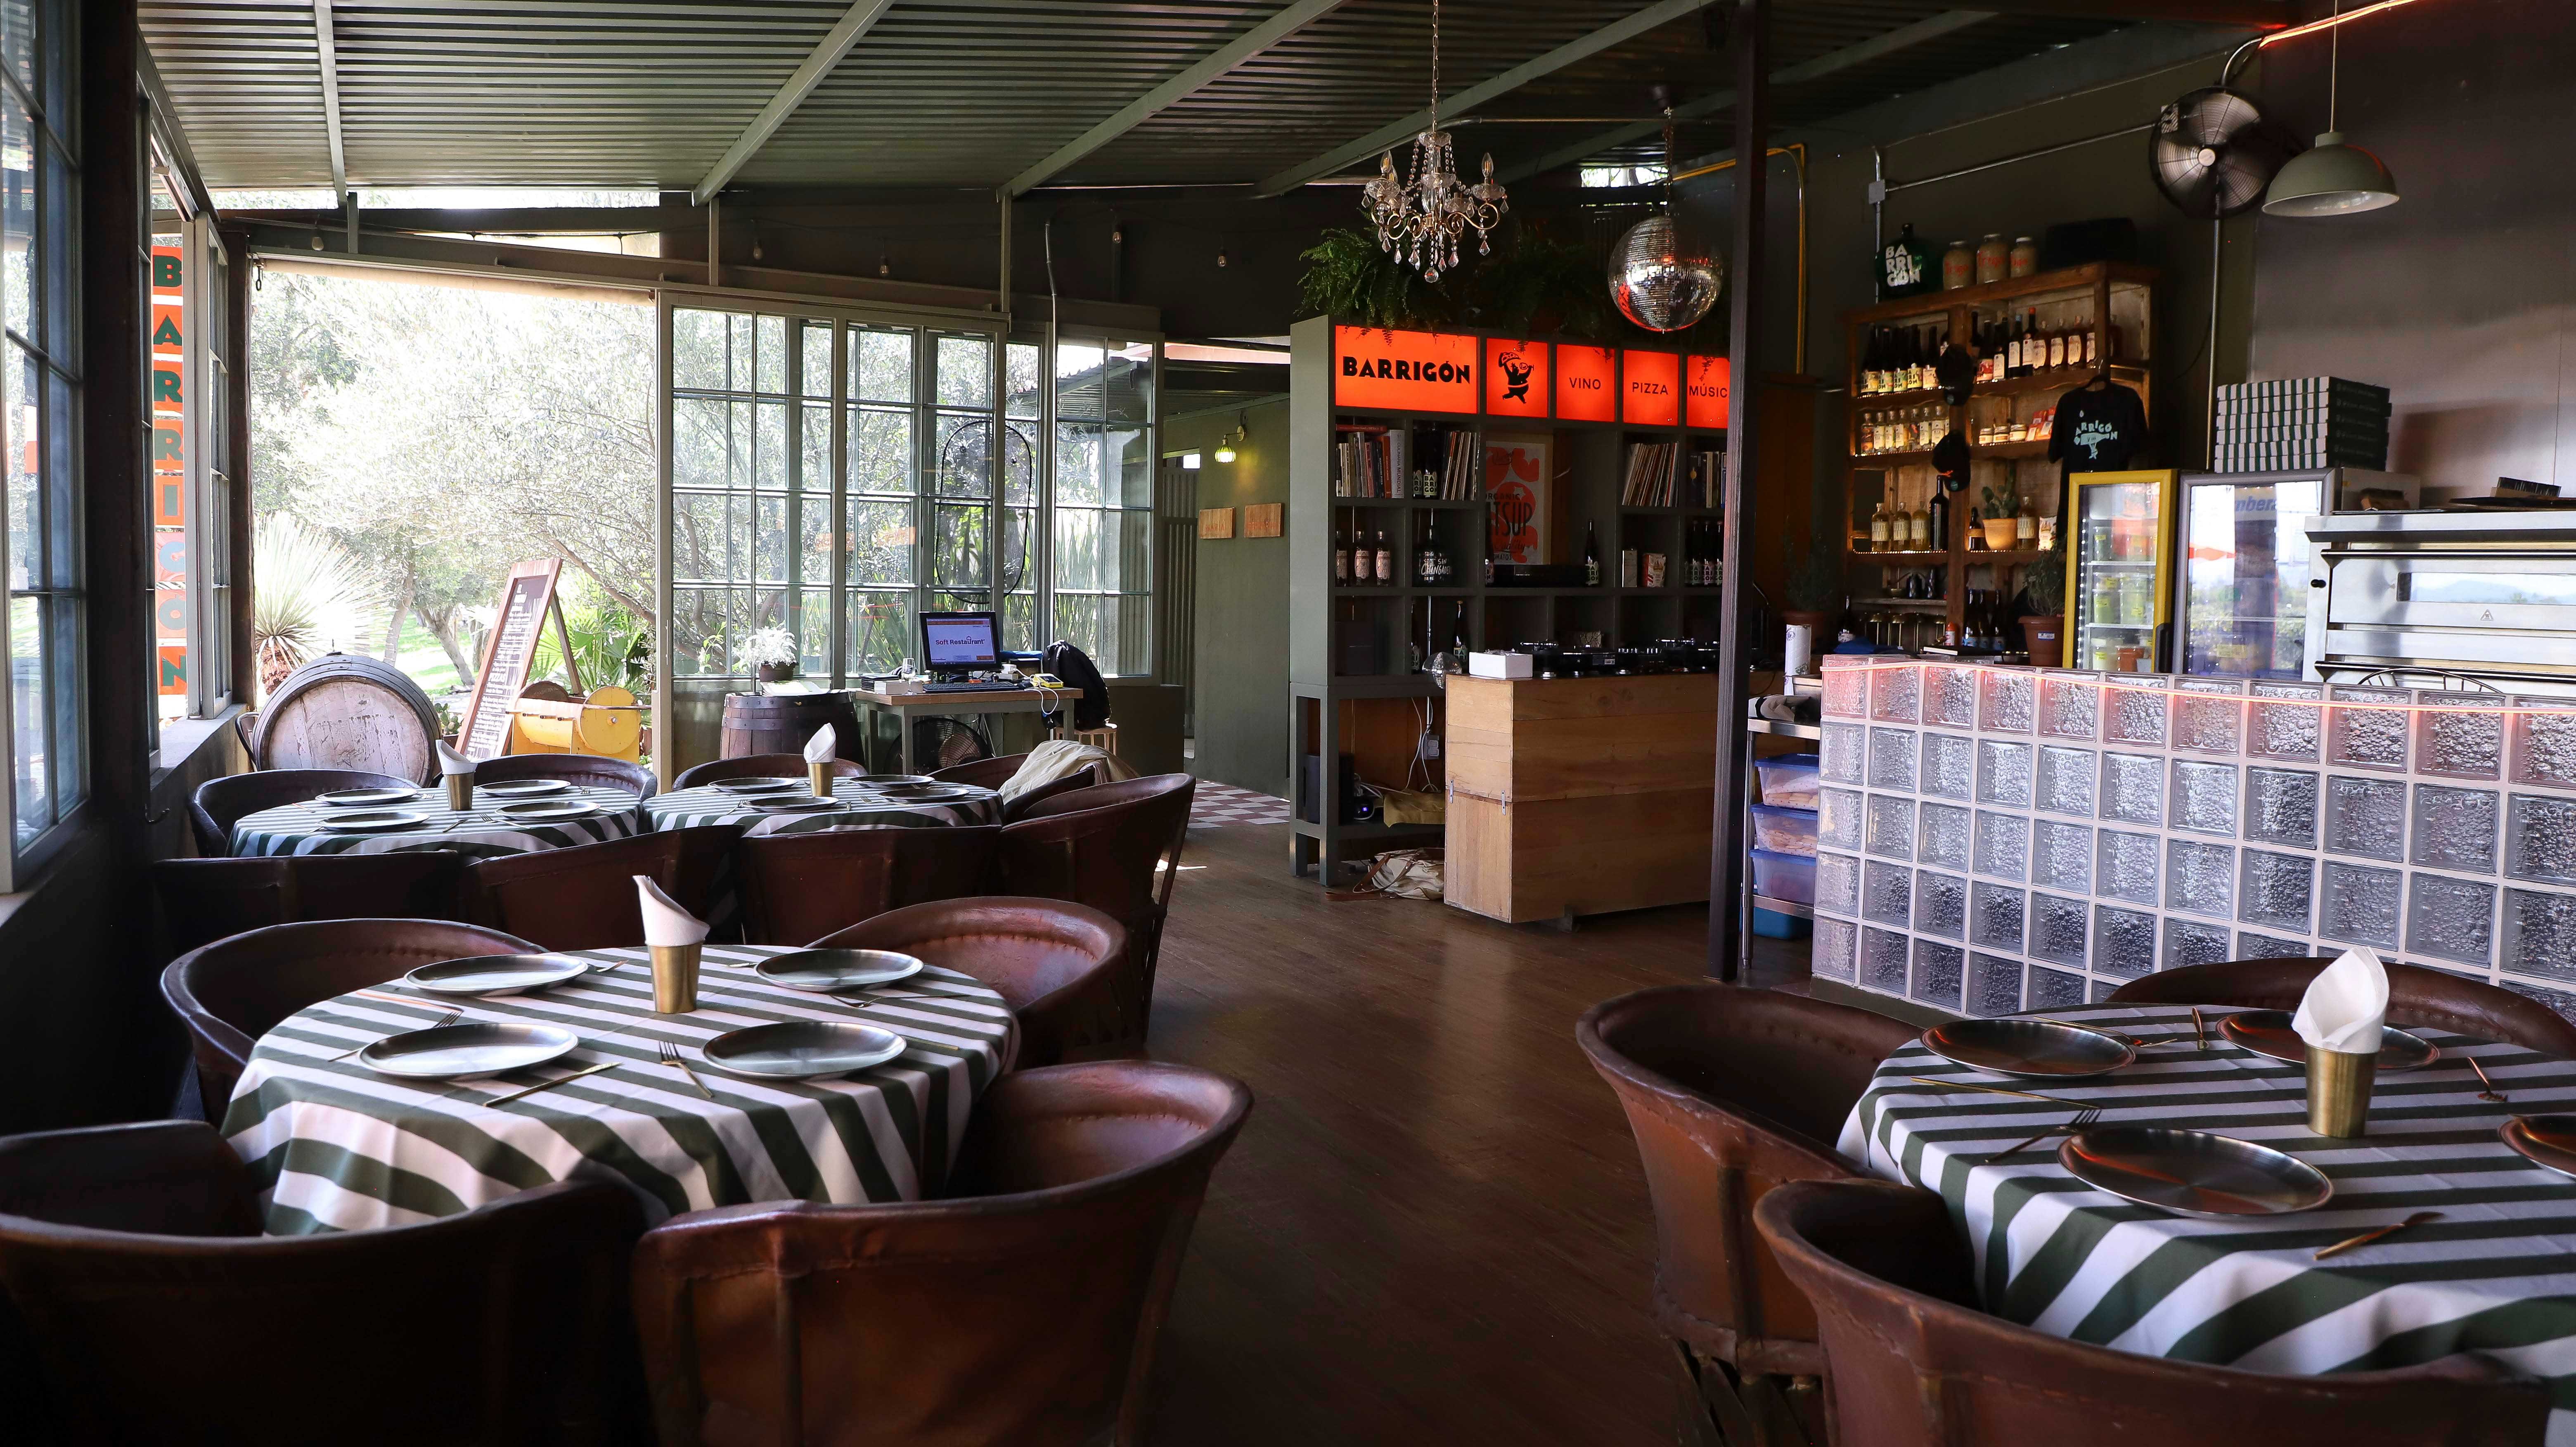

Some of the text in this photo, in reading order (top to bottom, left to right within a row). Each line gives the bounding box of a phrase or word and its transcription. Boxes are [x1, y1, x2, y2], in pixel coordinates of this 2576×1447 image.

[1885, 244, 1908, 258] BA
[1885, 255, 1913, 273] RRI
[1342, 356, 1470, 384] BARRIGÓN
[1569, 377, 1601, 390] VINO
[1632, 382, 1669, 395] PIZZA
[1689, 383, 1728, 398] MÚSIC
[1486, 501, 1532, 536] TSUP
